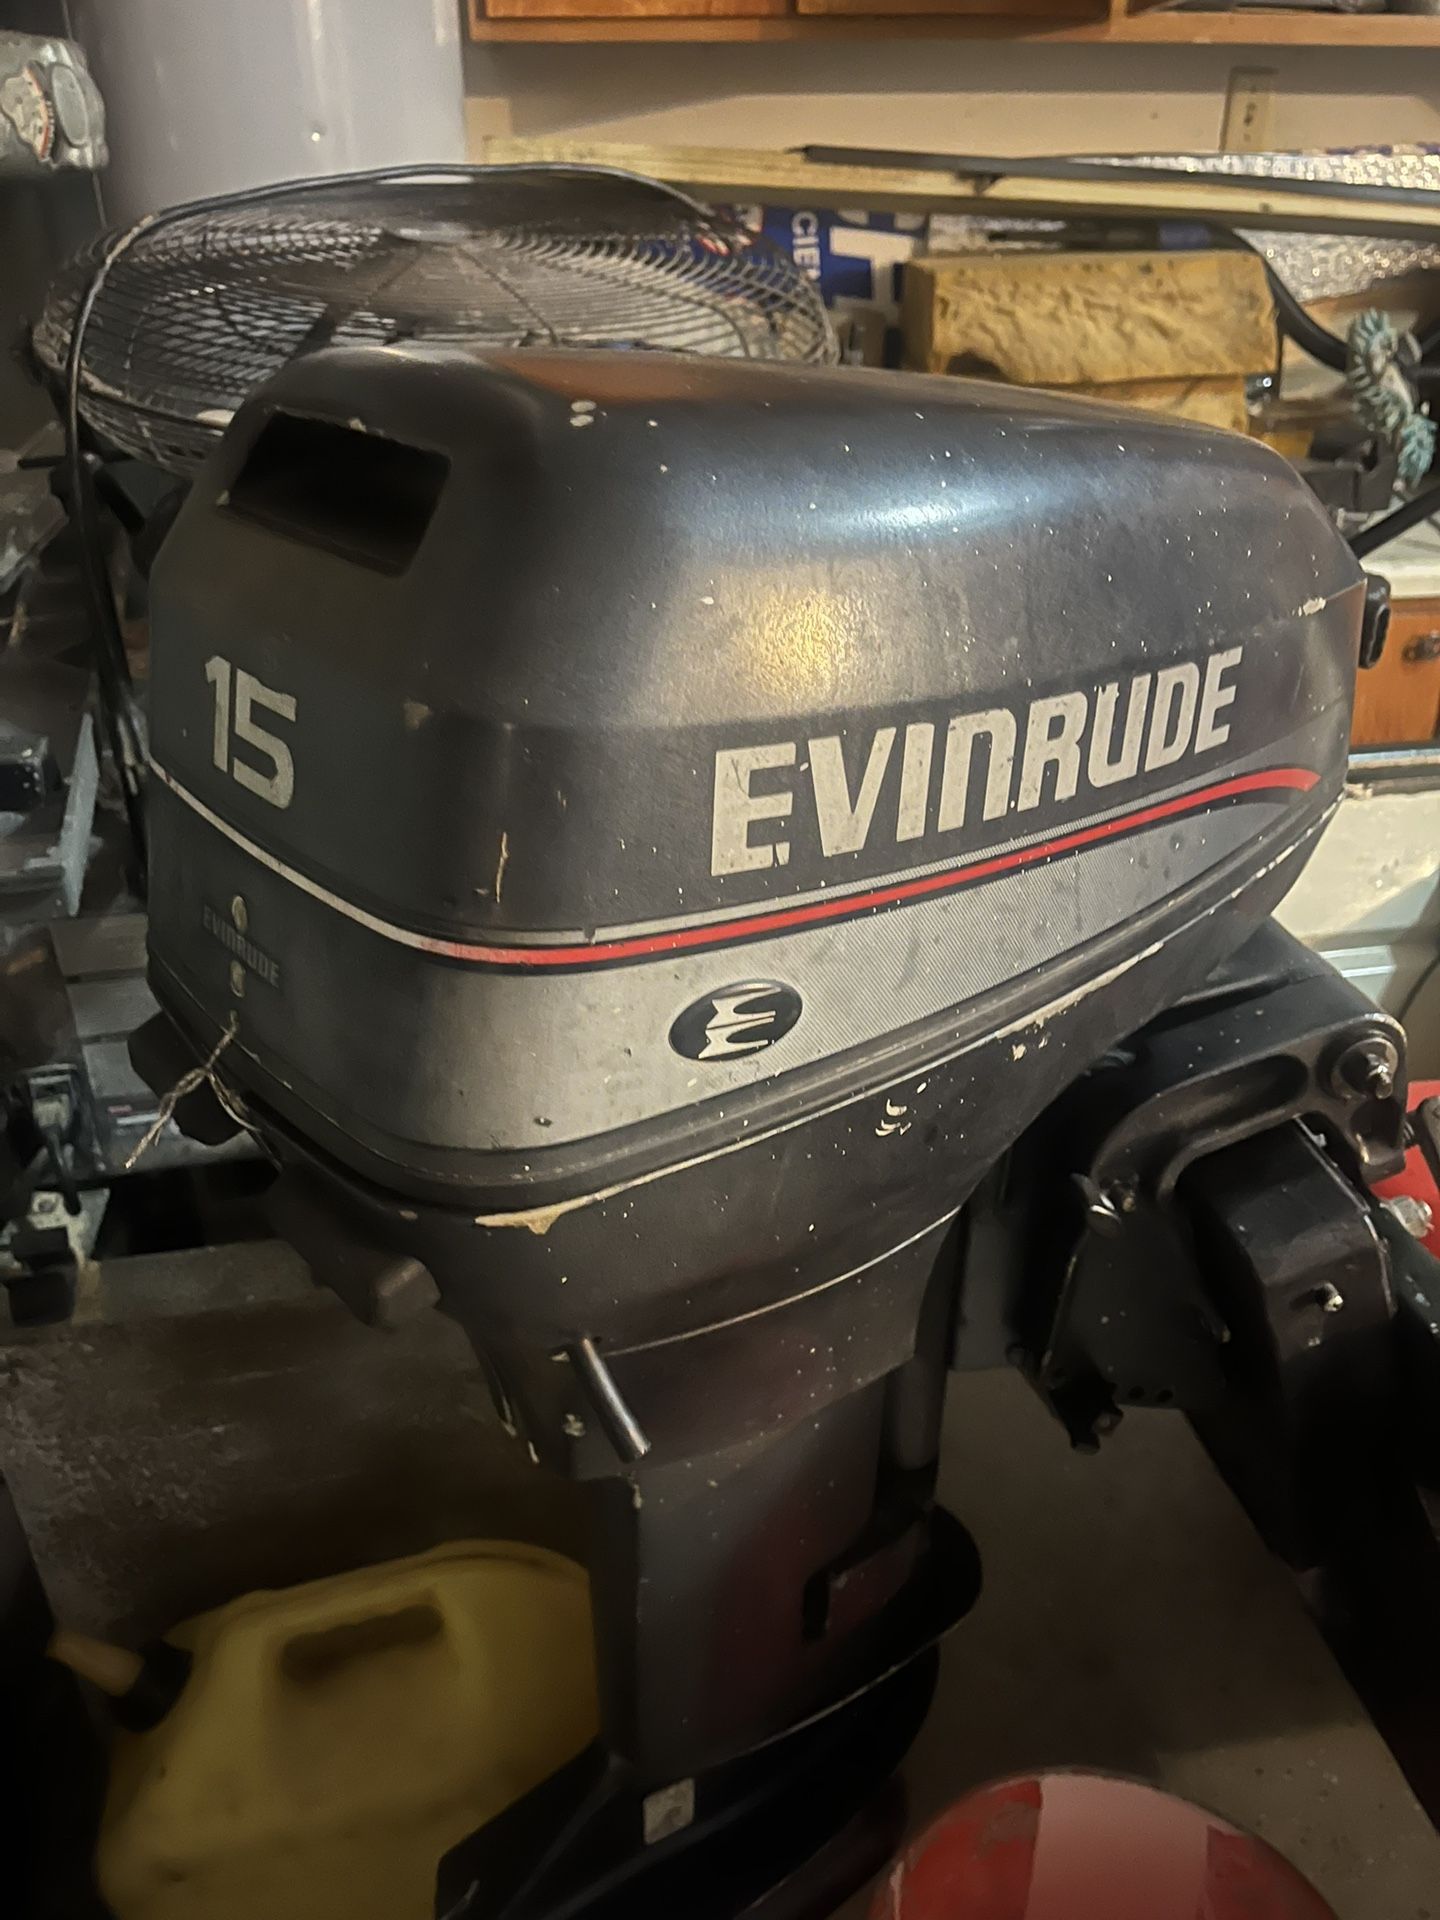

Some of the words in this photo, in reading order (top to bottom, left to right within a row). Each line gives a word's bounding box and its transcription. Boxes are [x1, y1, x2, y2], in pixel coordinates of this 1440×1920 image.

[205, 656, 297, 809] 15
[711, 646, 1243, 876] EVINRUDE
[203, 904, 280, 989] EVINRUDE
